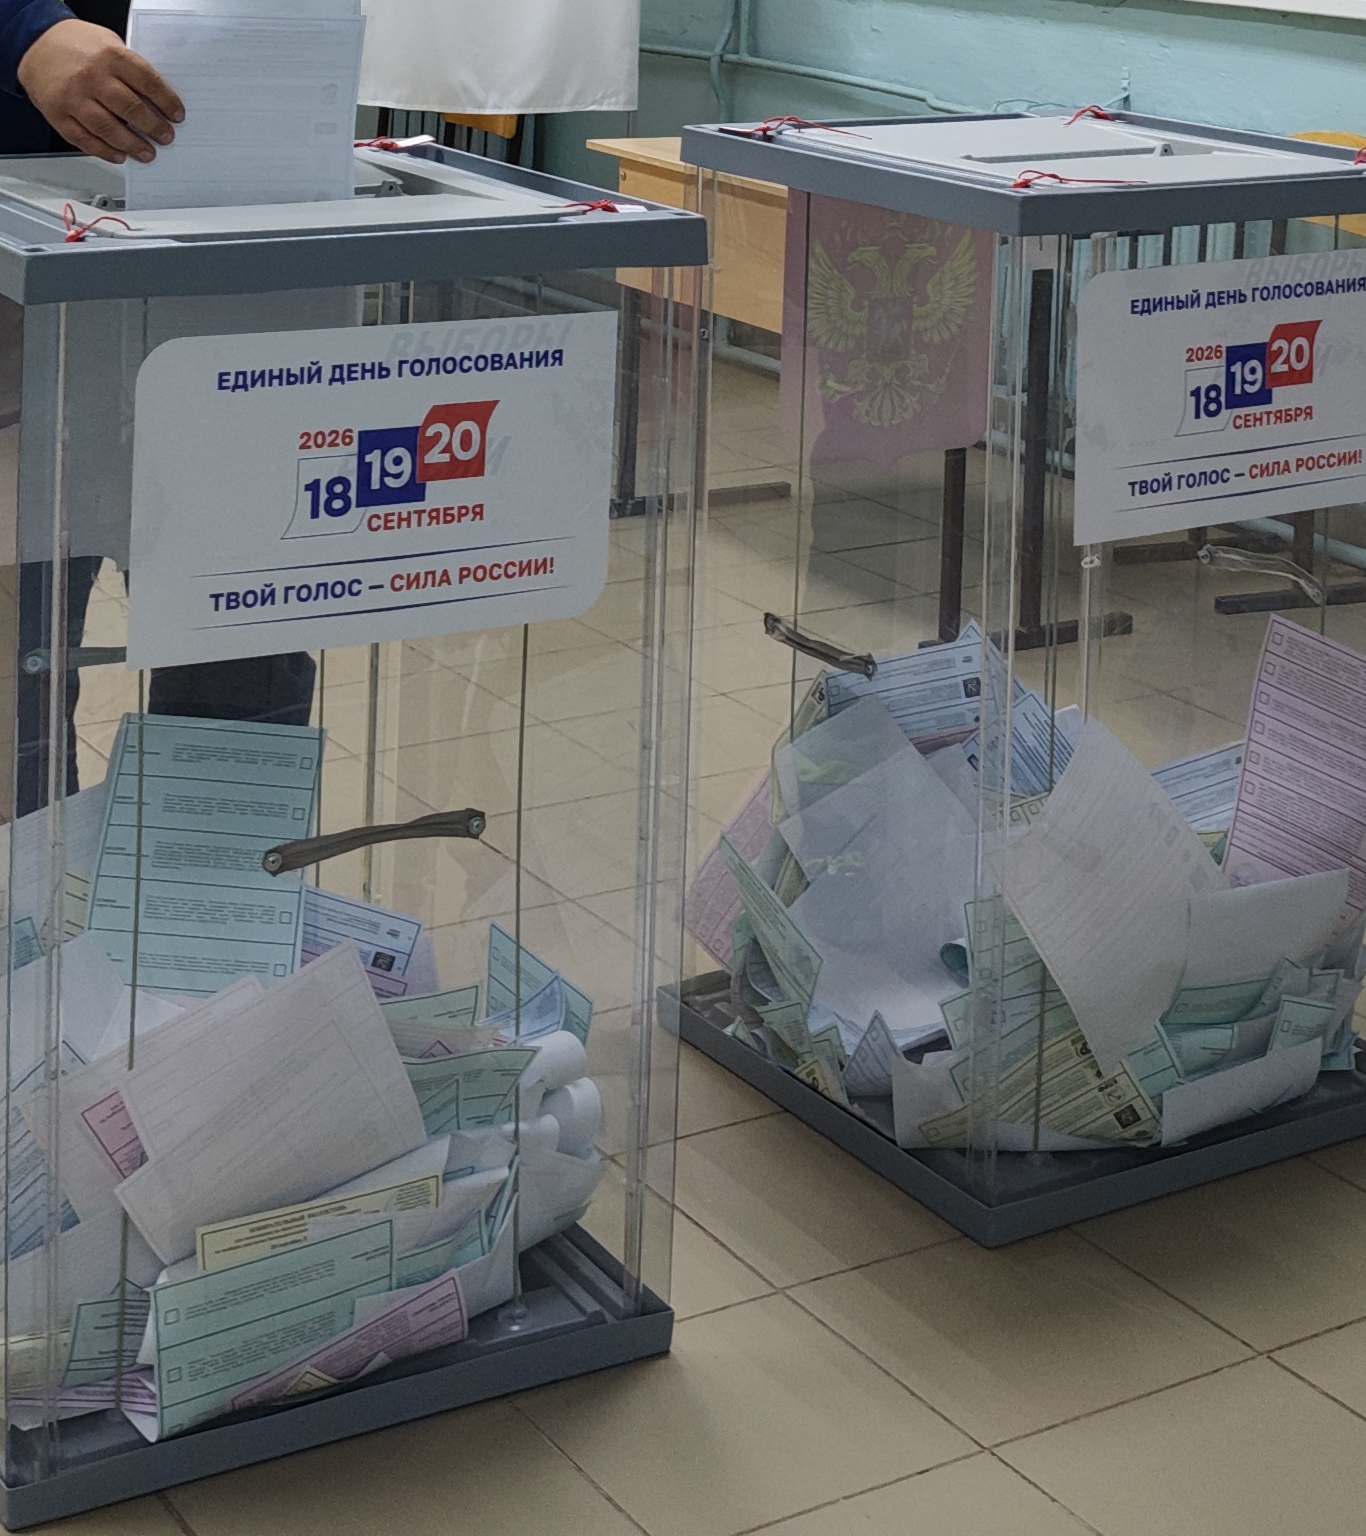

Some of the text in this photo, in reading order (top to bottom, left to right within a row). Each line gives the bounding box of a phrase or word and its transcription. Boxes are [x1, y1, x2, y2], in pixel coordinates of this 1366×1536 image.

[1130, 276, 1366, 316] ЕДИНЫЙ ДЕНЬ ГОЛОСОВАНИЯ
[217, 349, 564, 393] ЕДИНЫЙ ДЕНЬ ГОЛОСОВАНИЯ
[1185, 344, 1224, 363] 2026
[1189, 384, 1223, 420] 18
[1229, 359, 1263, 395] 19
[1270, 336, 1311, 373] 20
[1232, 405, 1314, 430] СЕНТЯБРЯ
[297, 428, 354, 451] 2026
[304, 475, 353, 520] 18
[364, 446, 412, 490] 19
[423, 420, 482, 464] 20
[1127, 472, 1173, 498] ТВОЙ
[1177, 468, 1231, 491] ГОЛОС
[1248, 460, 1292, 480] СИЛА
[1295, 449, 1363, 473] РОССИИ!
[366, 503, 485, 533] СЕНТЯБРЯ
[209, 582, 277, 612] ТВОЙ
[283, 578, 363, 605] ГОЛОС
[389, 568, 452, 593] СИЛА
[458, 556, 555, 585] РОССИИ!
